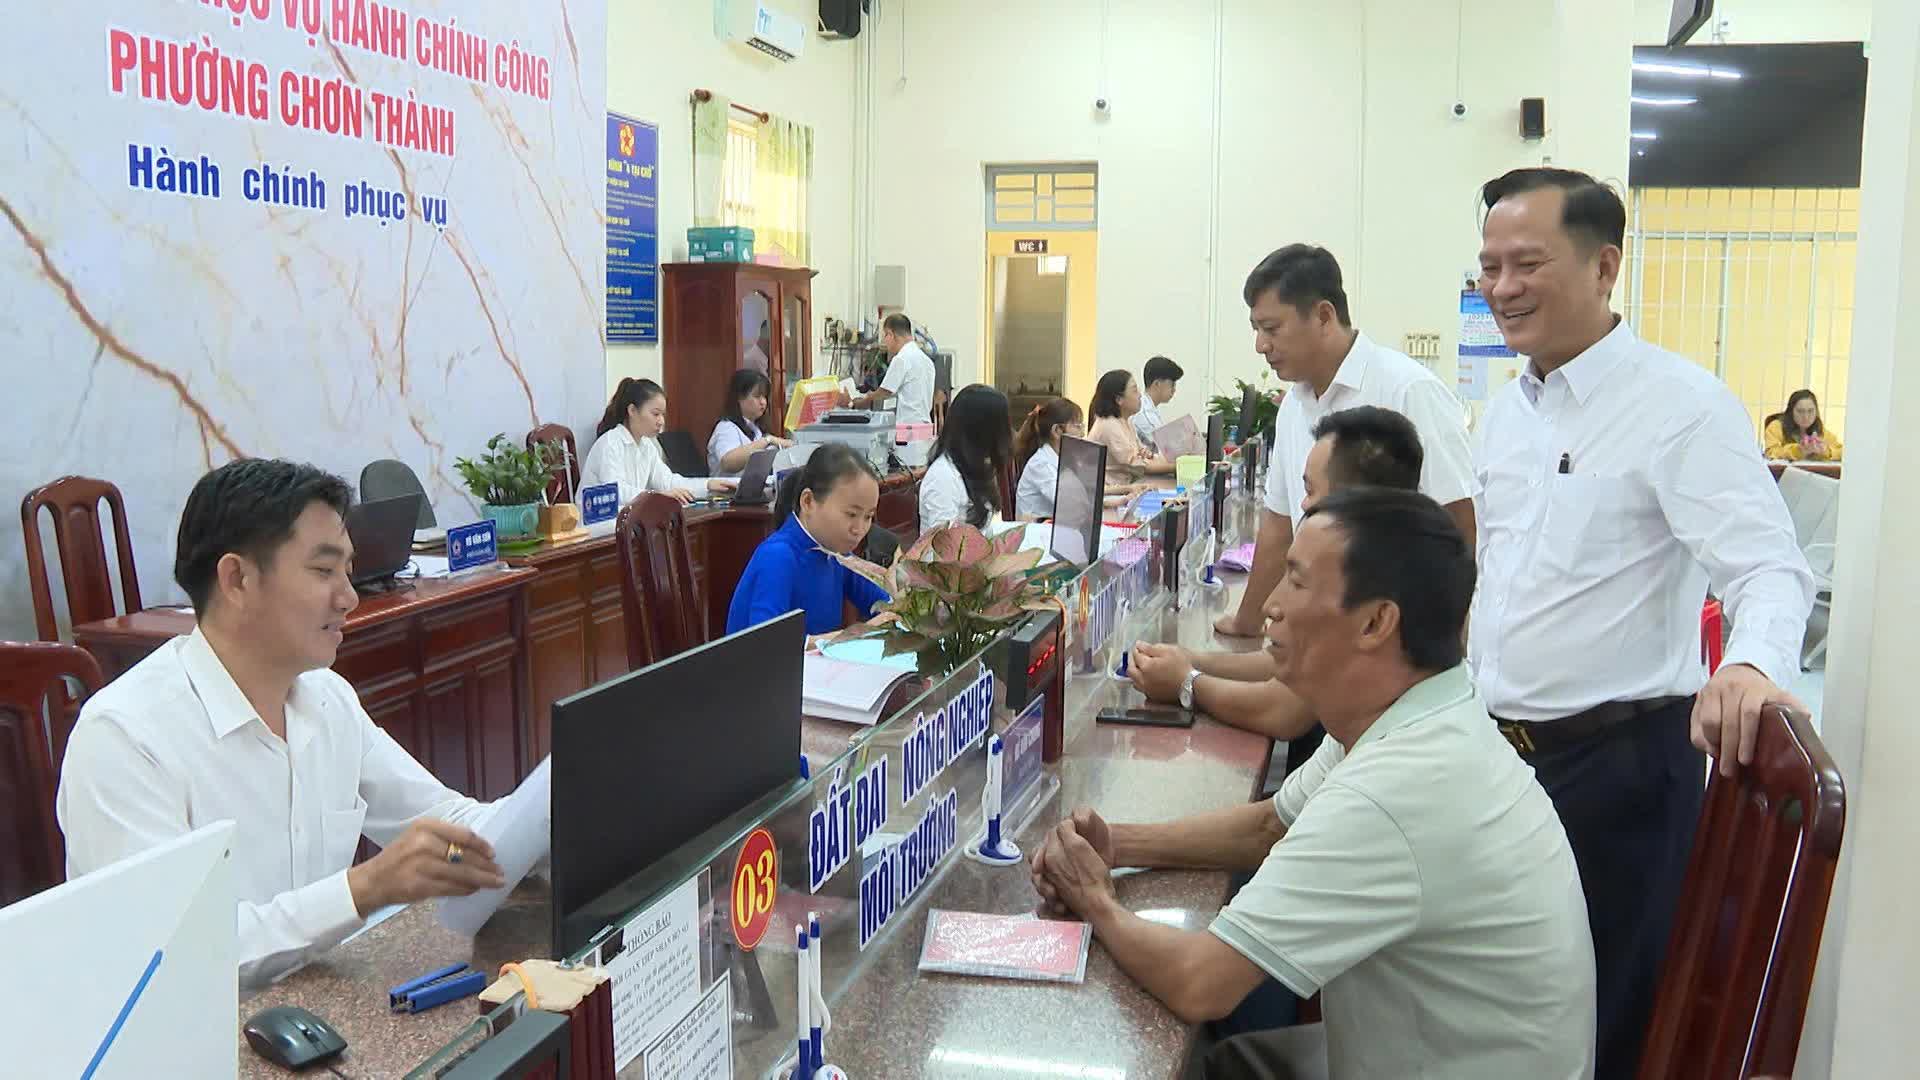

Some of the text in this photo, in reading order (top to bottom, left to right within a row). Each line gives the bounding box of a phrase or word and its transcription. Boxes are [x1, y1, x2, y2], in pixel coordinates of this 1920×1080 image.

[110, 30, 455, 156] PHƯỜNG CHƠN THÀNH
[416, 18, 487, 83] CHÍNH
[495, 40, 549, 100] CÔNG
[128, 144, 447, 232] Hành chính phục vụ
[1019, 241, 1035, 252] WC
[903, 664, 993, 804] NÔNG NGHIỆP
[811, 757, 888, 890] ĐẤT ĐAI
[861, 793, 956, 946] MÔI TRƯỜNG
[737, 850, 774, 928] 03
